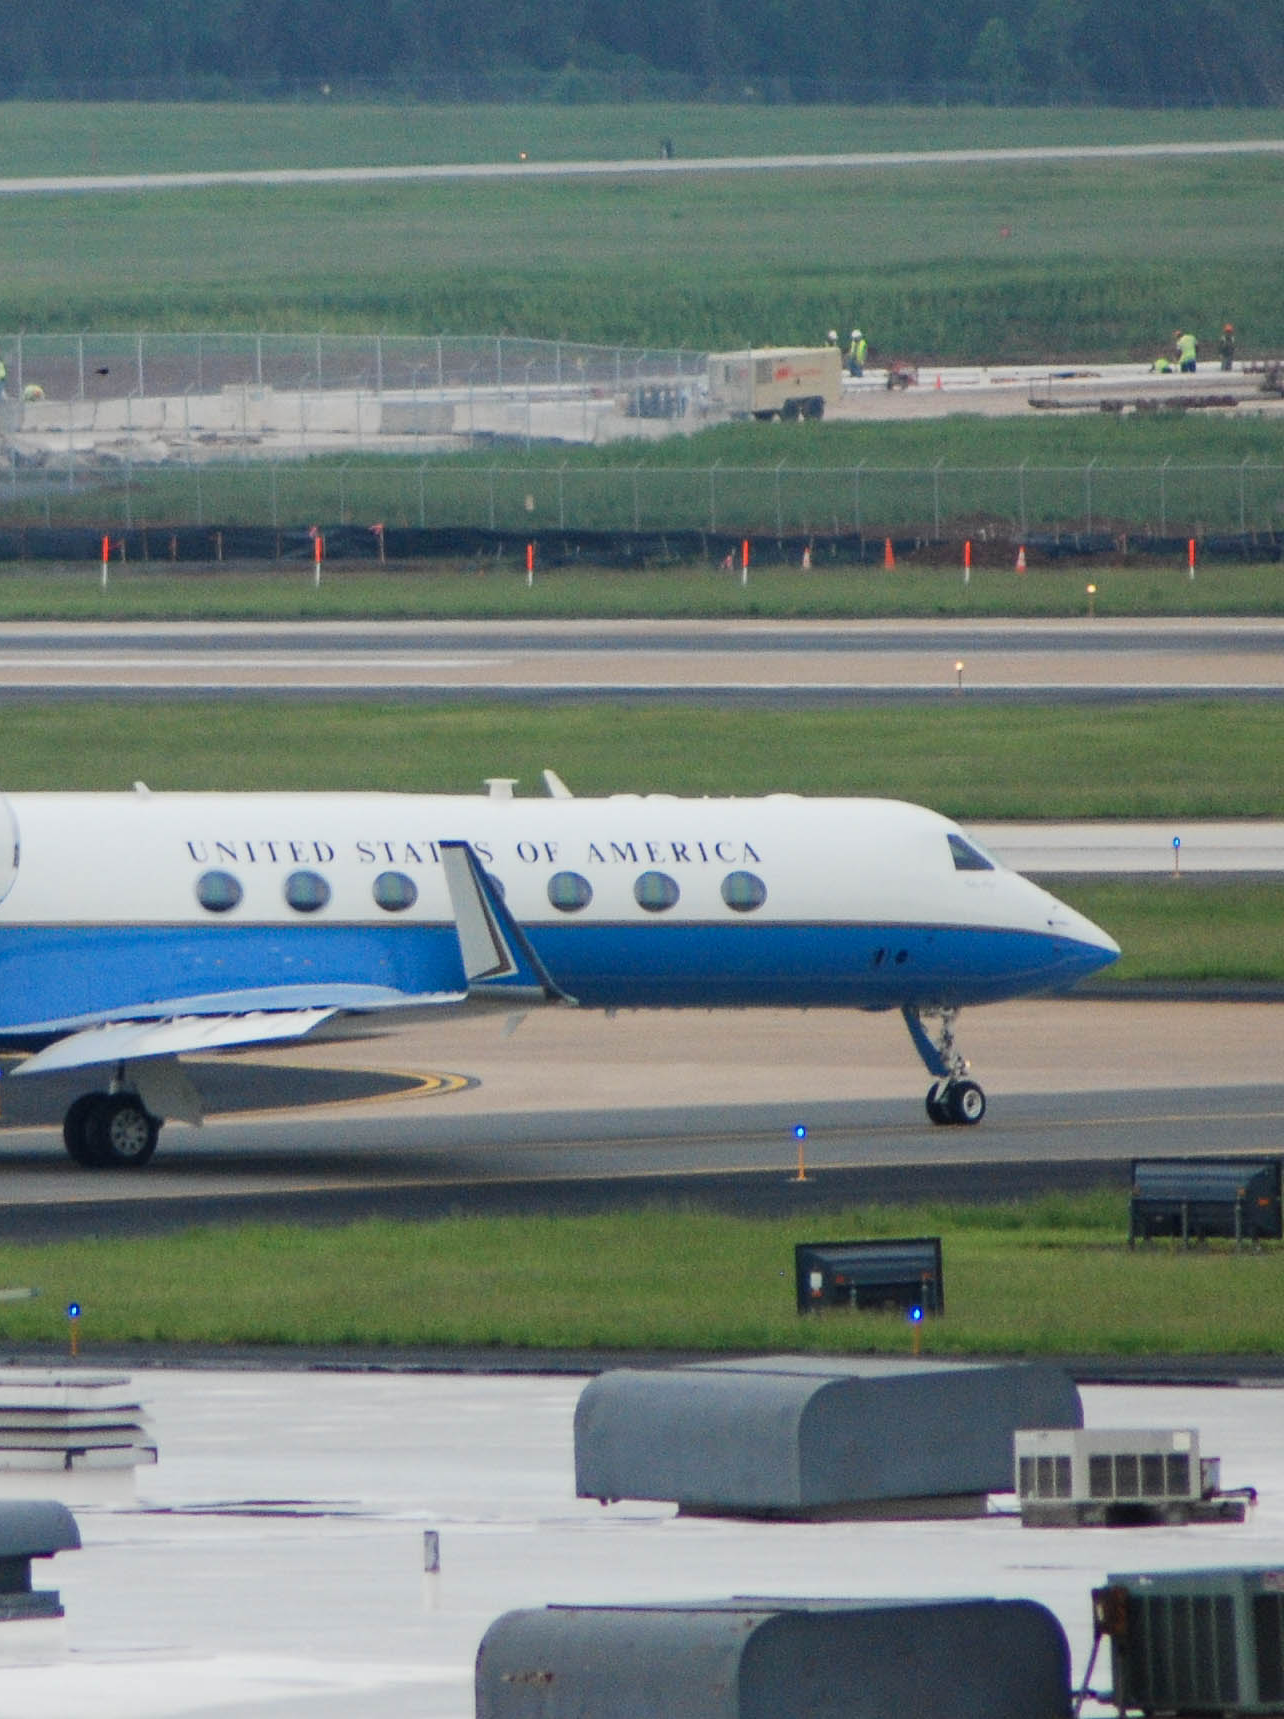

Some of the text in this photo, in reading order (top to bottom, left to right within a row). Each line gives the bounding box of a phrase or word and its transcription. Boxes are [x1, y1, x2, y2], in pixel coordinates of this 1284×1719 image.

[187, 840, 762, 863] UNITED STATS OF AMERICA
